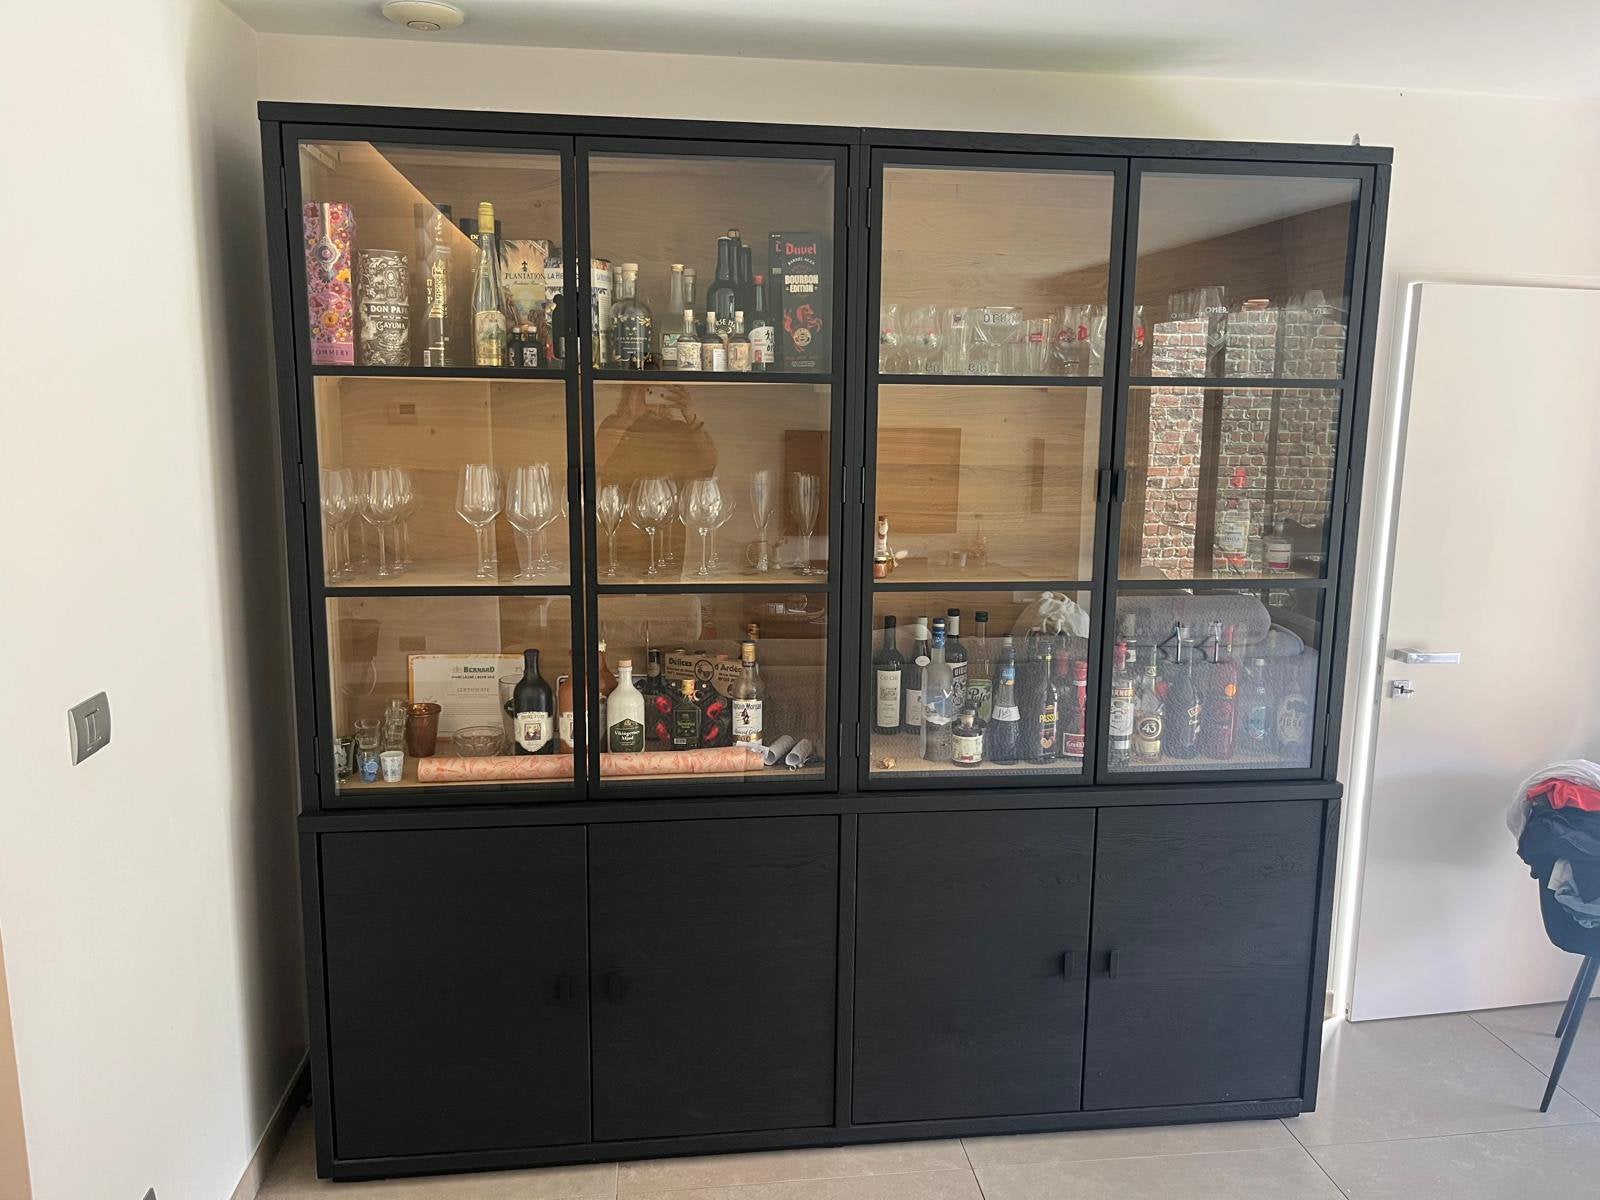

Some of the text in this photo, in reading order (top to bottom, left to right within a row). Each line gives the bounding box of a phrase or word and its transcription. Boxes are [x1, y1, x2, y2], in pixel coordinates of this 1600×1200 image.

[784, 242, 817, 255] Duvel
[505, 272, 545, 280] PLANTATION
[784, 274, 819, 284] BOURBON
[790, 284, 814, 293] EDITION
[370, 305, 389, 313] DON
[376, 321, 406, 331] GAYUMA
[1141, 723, 1157, 734] 43
